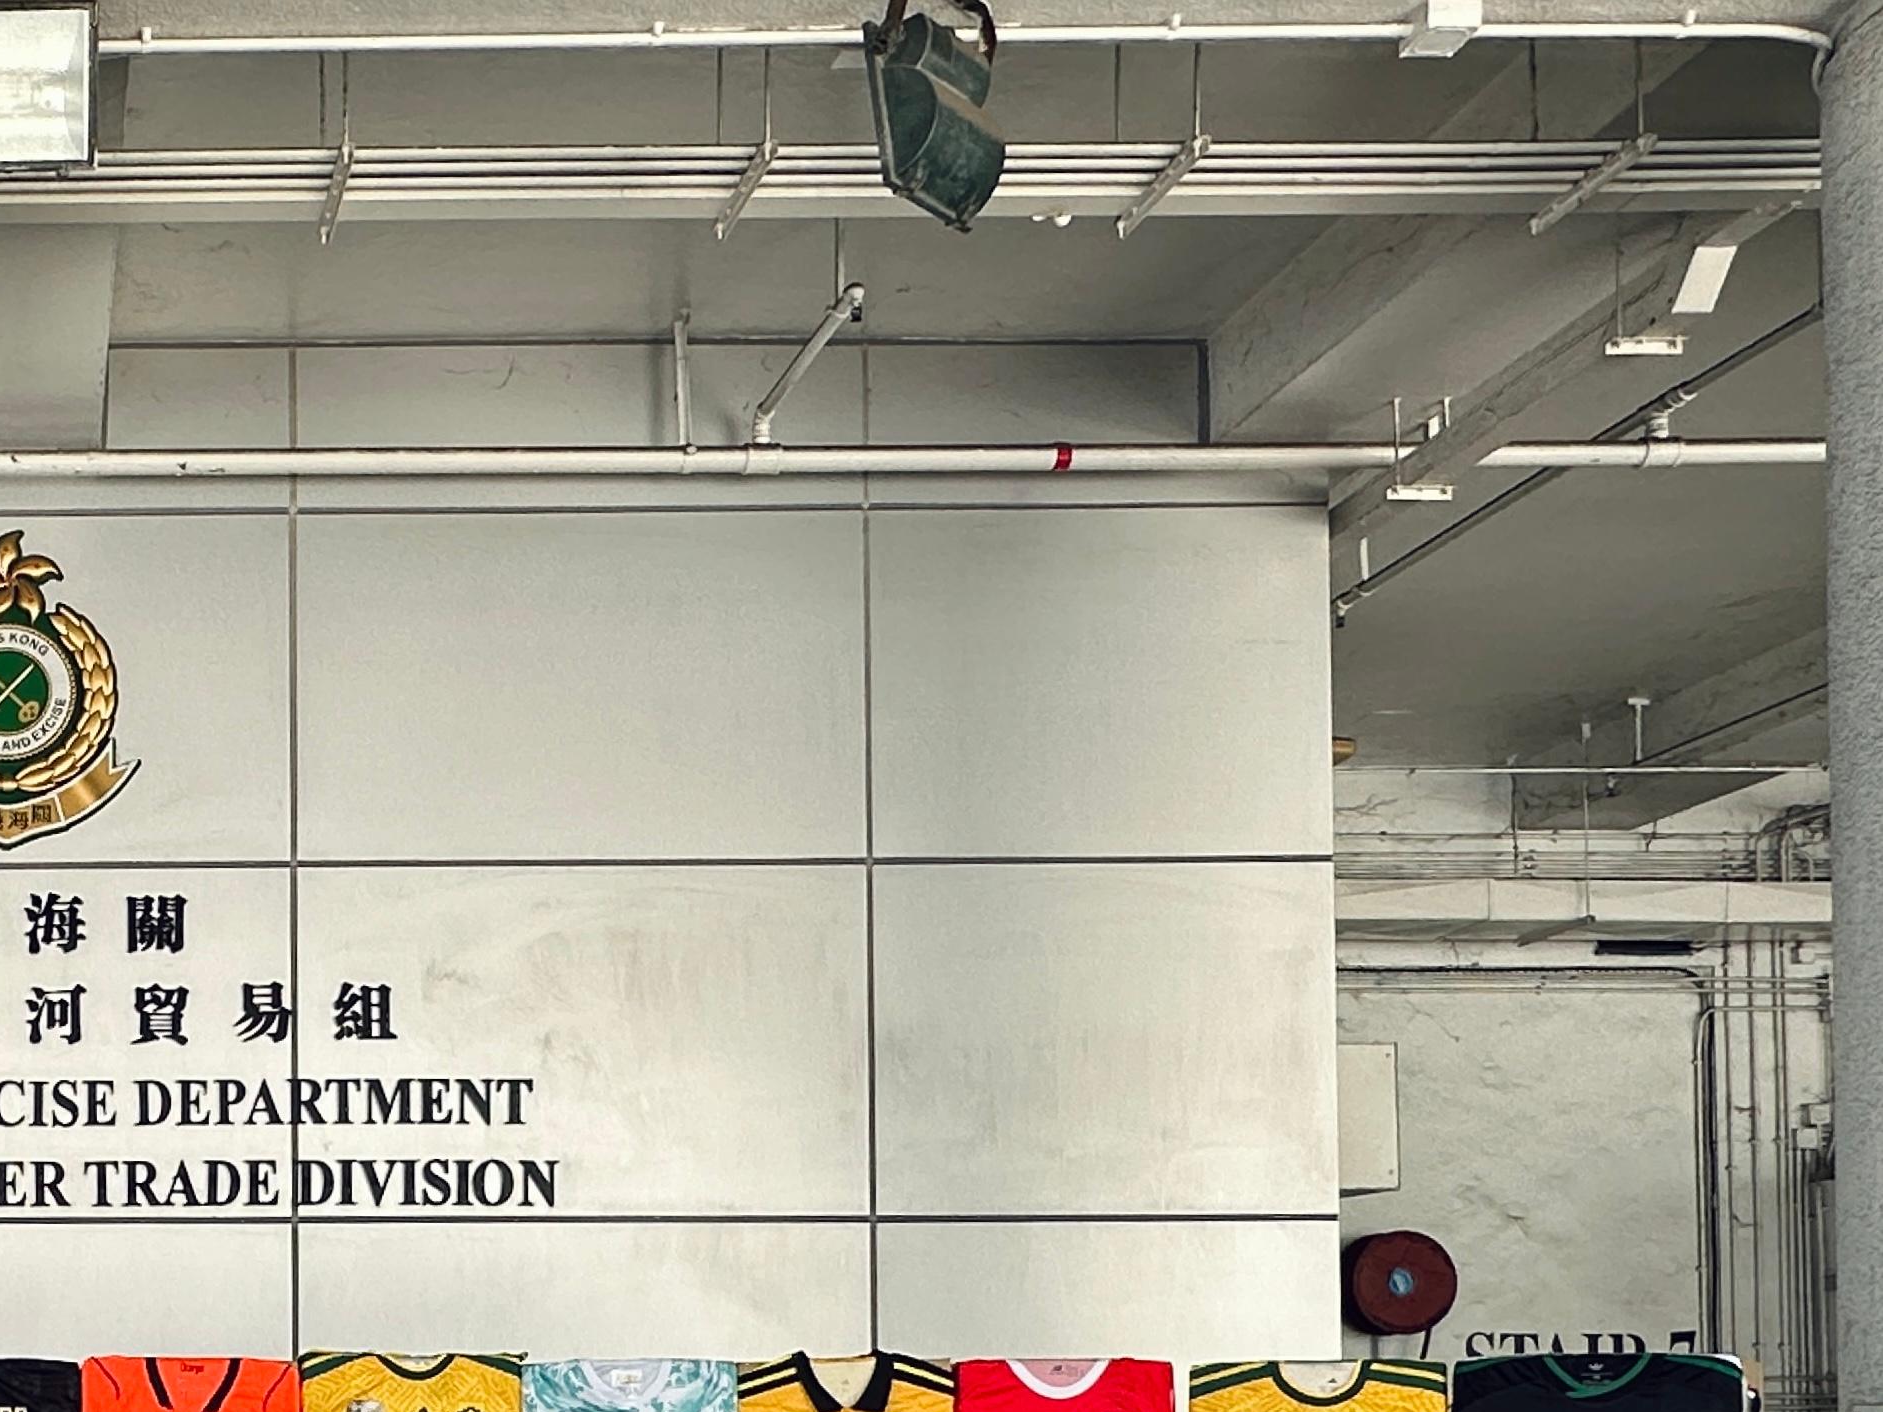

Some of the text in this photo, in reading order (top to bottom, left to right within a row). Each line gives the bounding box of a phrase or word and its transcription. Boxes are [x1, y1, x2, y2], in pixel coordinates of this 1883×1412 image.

[9, 632, 50, 657] KONG
[1, 735, 31, 751] AND
[33, 697, 67, 743] EXCISE
[133, 1078, 535, 1127] DEPARTMENT
[83, 1159, 281, 1207] TRADE
[297, 1158, 561, 1208] DIVISION
